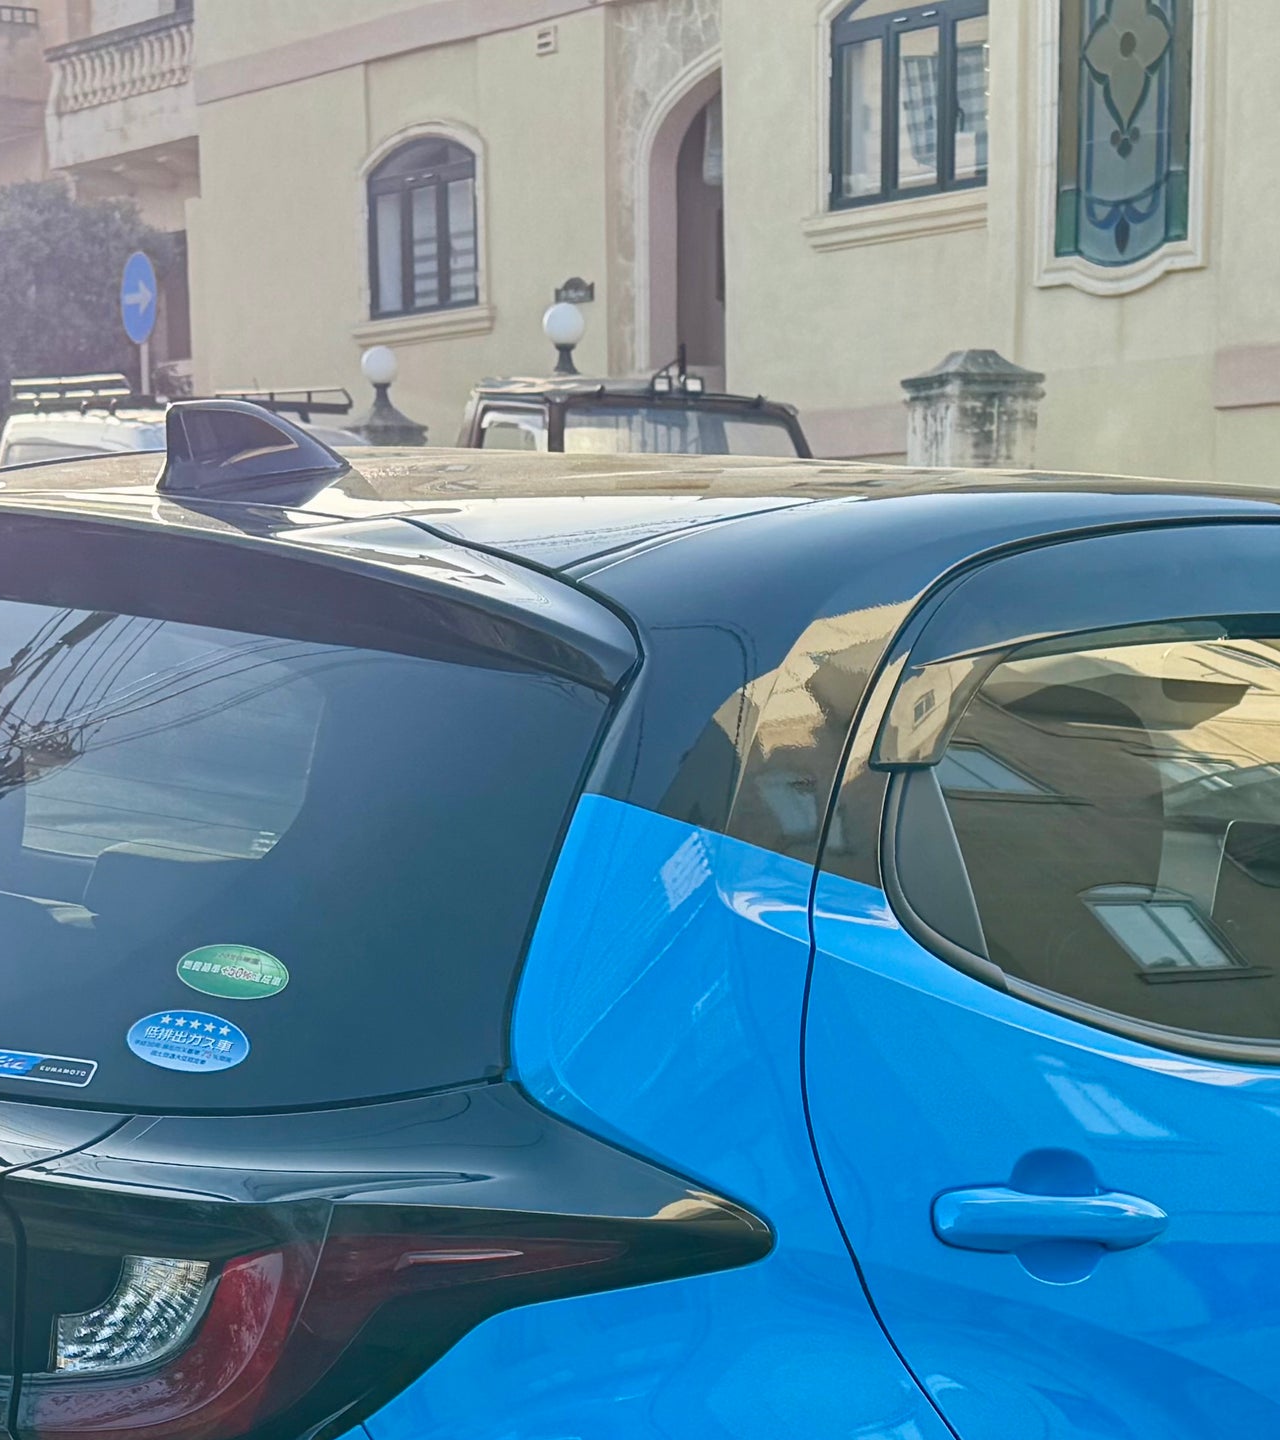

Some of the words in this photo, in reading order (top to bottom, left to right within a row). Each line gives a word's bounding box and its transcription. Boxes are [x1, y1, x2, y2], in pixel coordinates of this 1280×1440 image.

[144, 1025, 235, 1054] 低排出ガス車
[39, 1065, 87, 1077] KUMAMOTO
